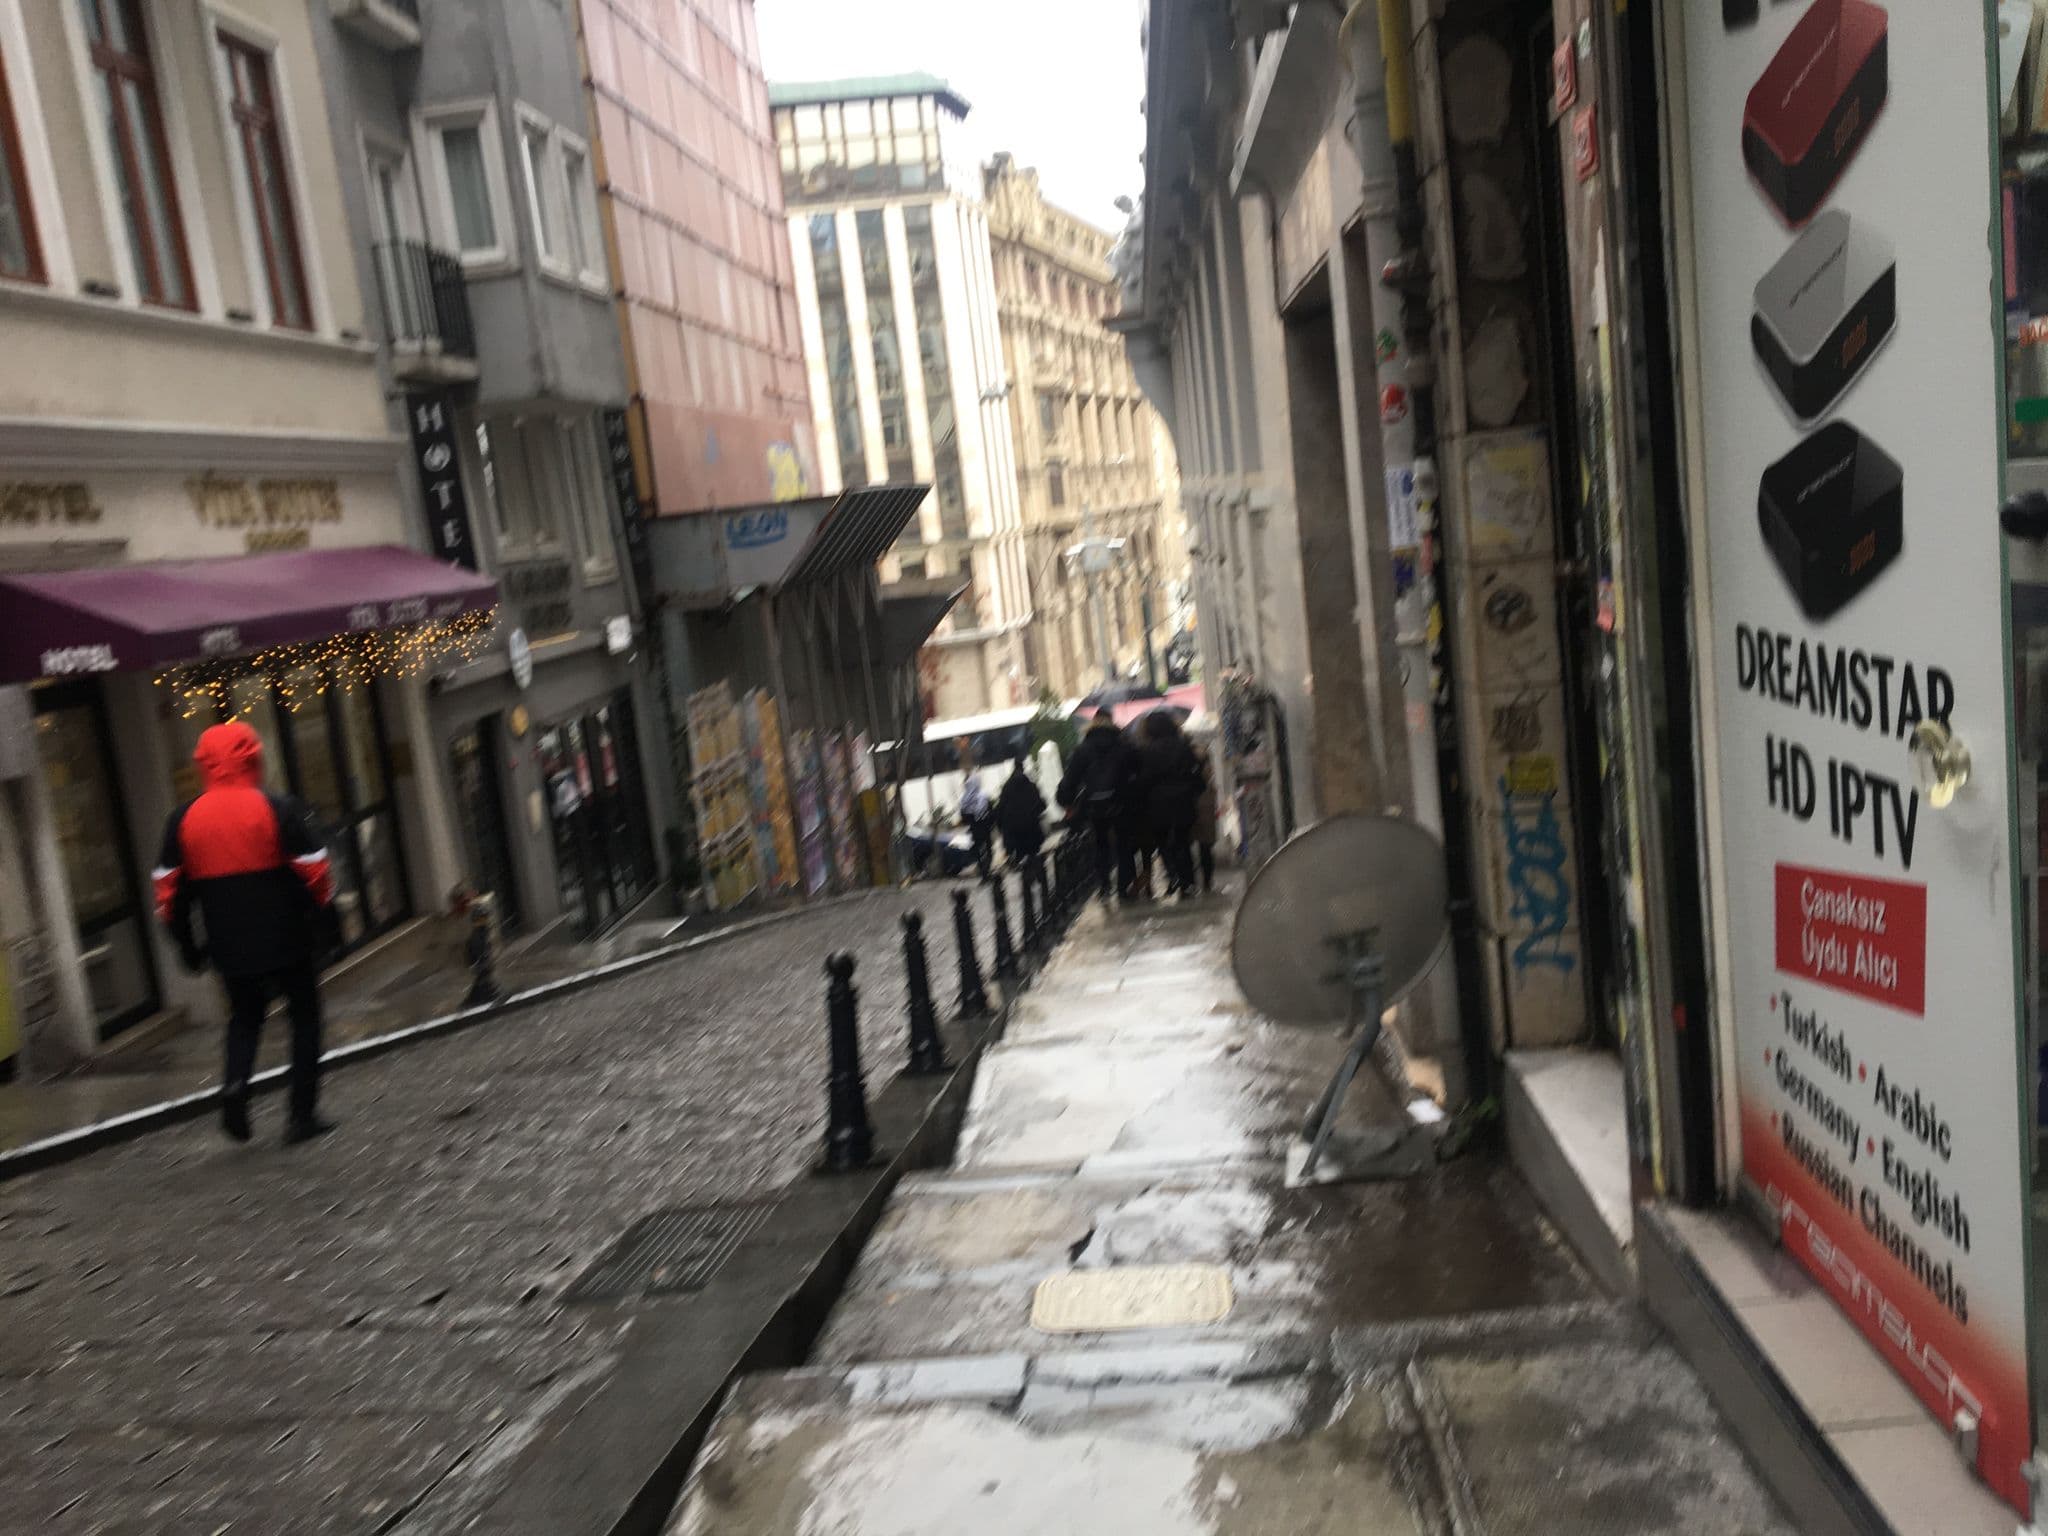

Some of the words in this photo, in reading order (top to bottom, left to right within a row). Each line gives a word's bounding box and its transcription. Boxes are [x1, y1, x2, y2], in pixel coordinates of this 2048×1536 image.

[416, 401, 464, 568] HOTE
[41, 643, 119, 675] HOTEL
[1736, 622, 1955, 752] DREAMSTAR
[1766, 732, 1816, 822] HD
[1828, 757, 1919, 870] IPTV
[1776, 1048, 1860, 1166] Germany
[1883, 1137, 1970, 1255] English
[1781, 990, 1852, 1084] Turkish
[1874, 1064, 1952, 1164] Arabic
